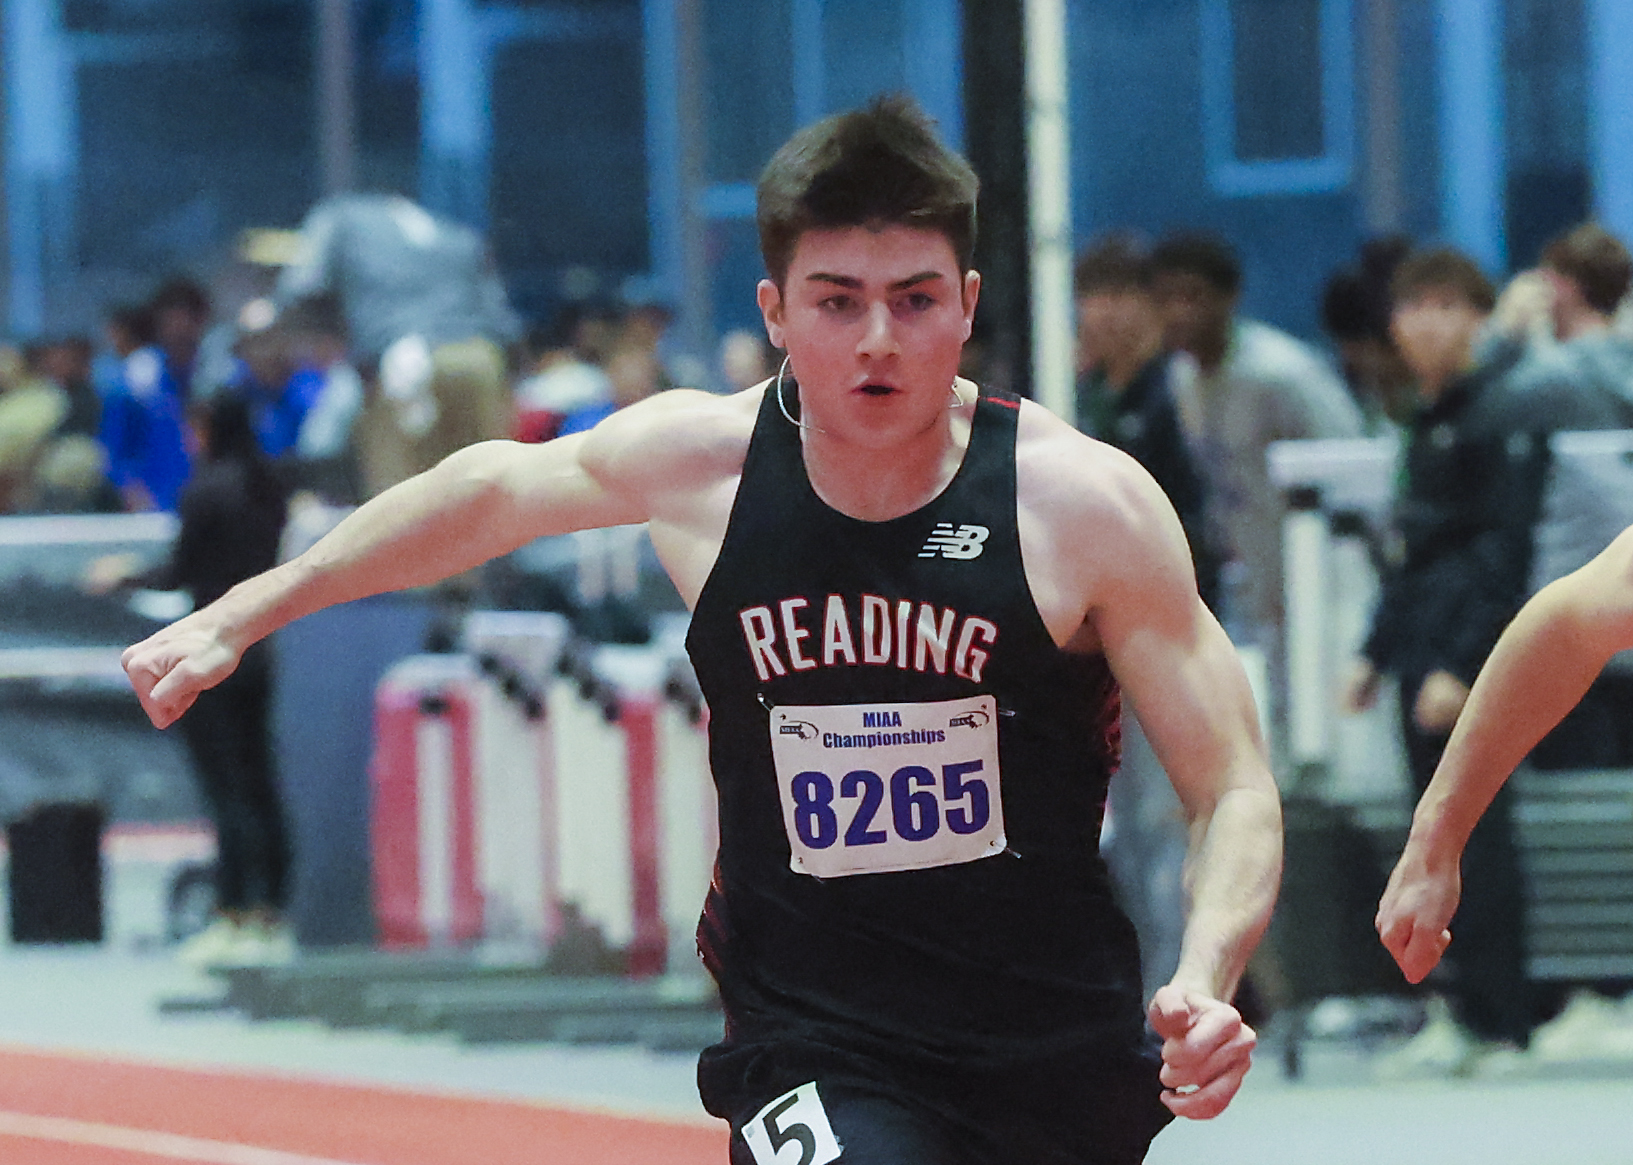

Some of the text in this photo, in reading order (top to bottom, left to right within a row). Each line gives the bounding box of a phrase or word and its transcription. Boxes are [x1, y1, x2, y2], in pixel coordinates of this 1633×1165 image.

[739, 593, 1000, 685] READING
[822, 728, 946, 749] Championships
[862, 710, 902, 728] MIAA
[790, 759, 991, 850] 8265
